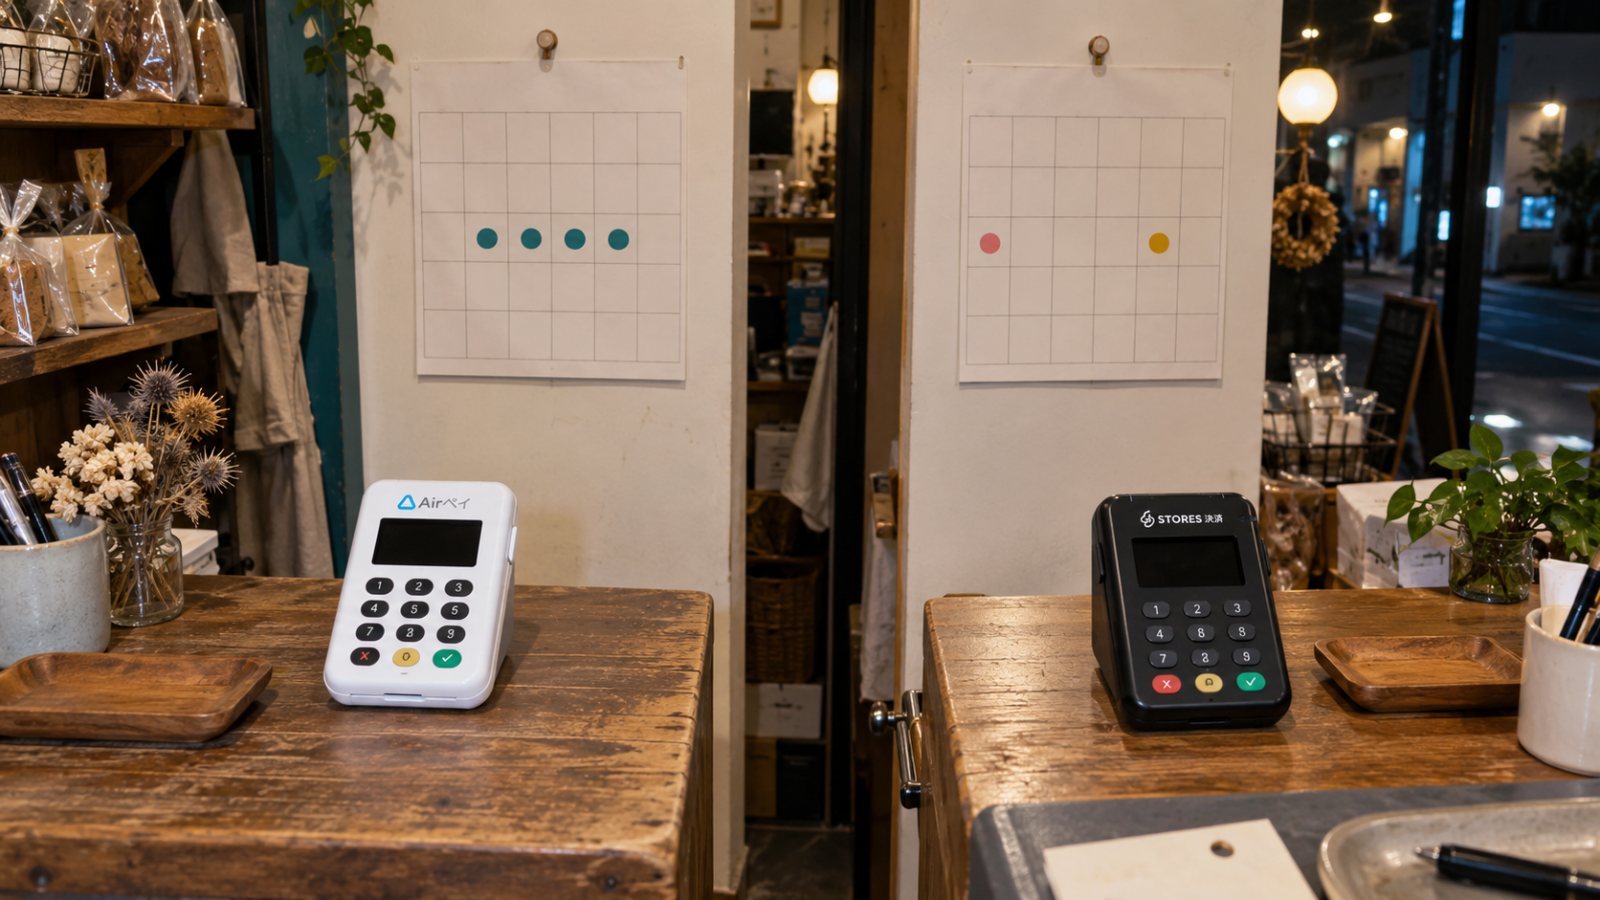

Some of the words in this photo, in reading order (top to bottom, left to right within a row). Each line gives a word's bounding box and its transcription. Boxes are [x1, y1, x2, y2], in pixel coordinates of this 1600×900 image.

[418, 496, 472, 510] Airペイ
[1158, 514, 1203, 524] STORES
[377, 581, 383, 590] 1
[414, 582, 423, 591] 2
[454, 583, 463, 592] 3
[370, 603, 378, 612] 4
[410, 605, 418, 614] 5
[1154, 605, 1159, 615] 1
[1194, 604, 1202, 614] 2
[1233, 603, 1241, 613] 3
[366, 627, 374, 636] 7
[1156, 629, 1164, 639] 4
[1159, 654, 1167, 664] 7
[1242, 652, 1251, 662] 9
